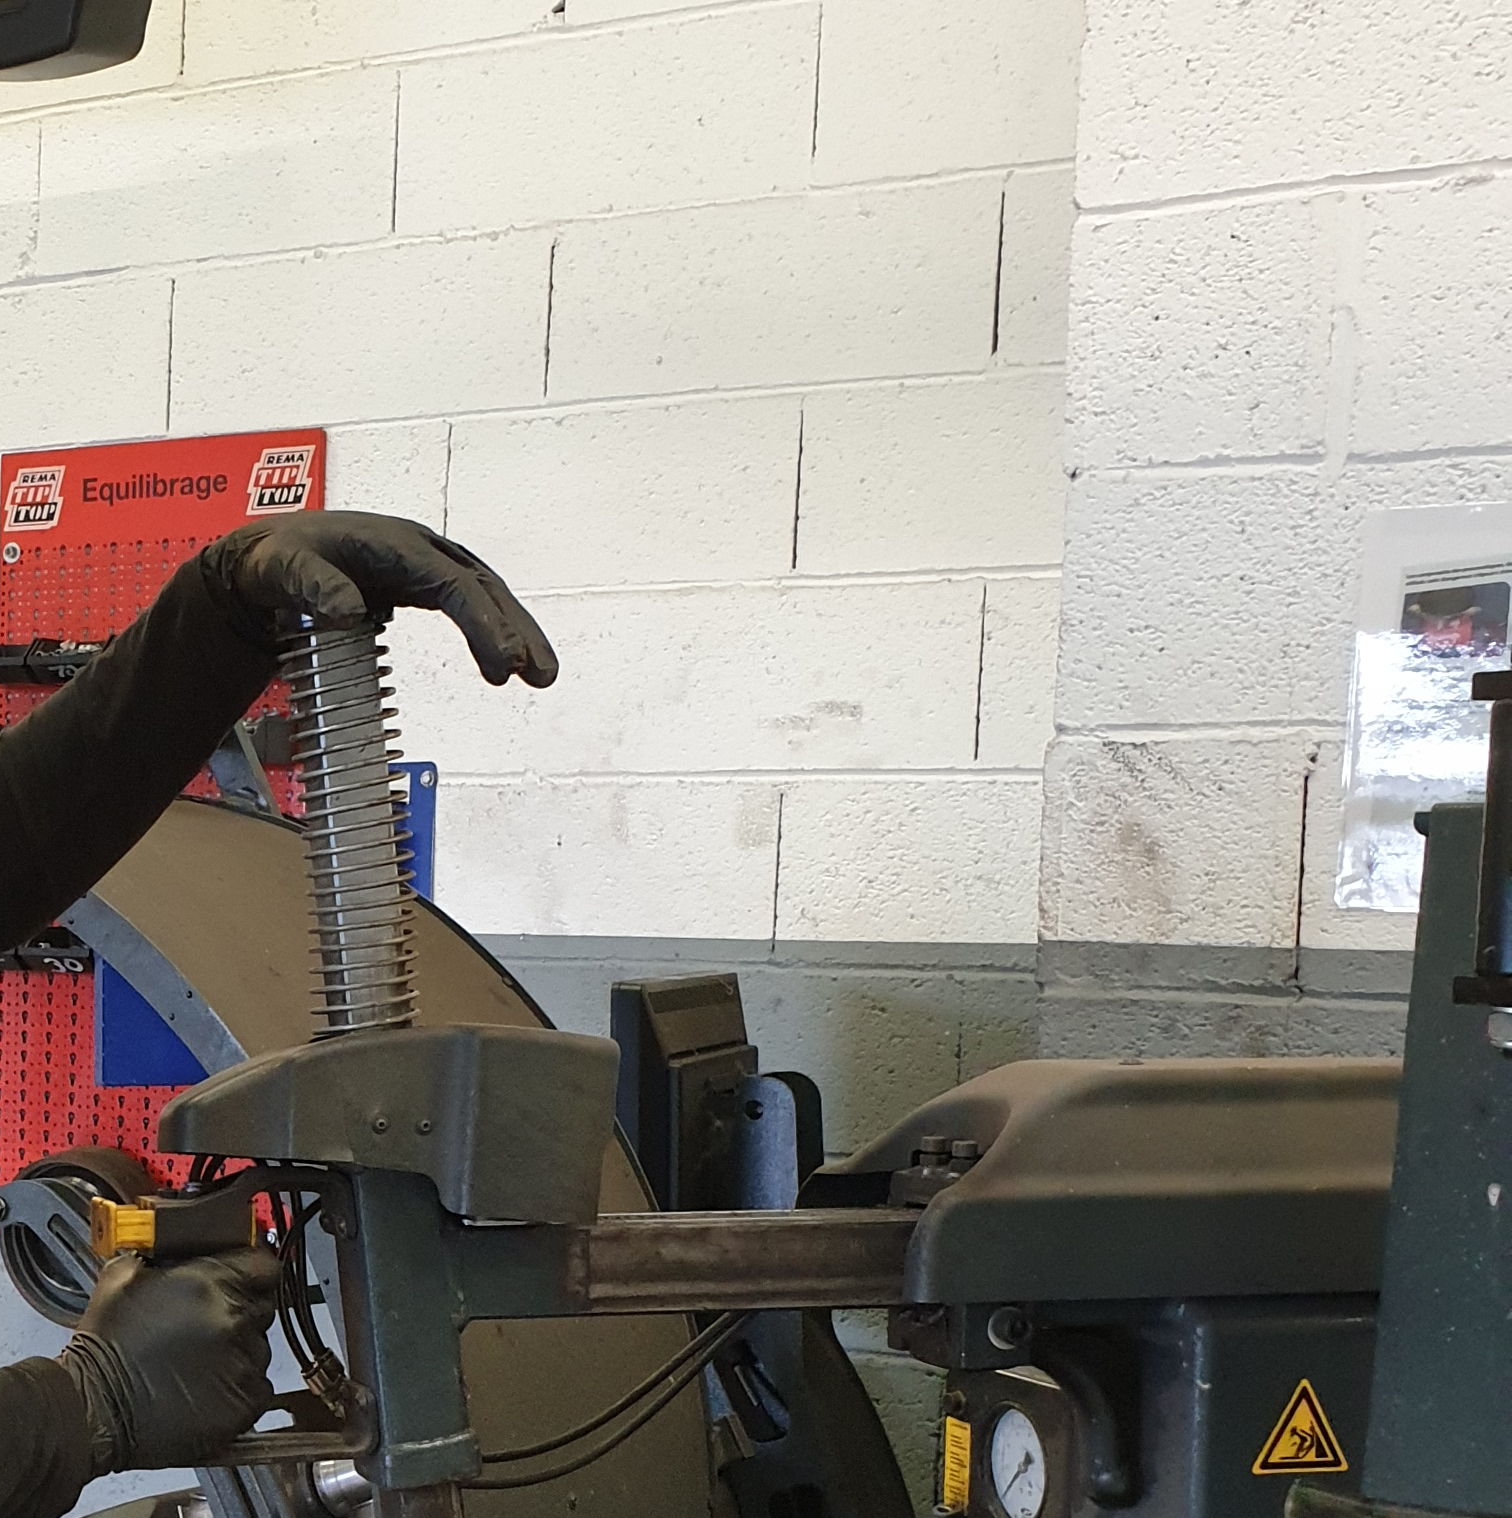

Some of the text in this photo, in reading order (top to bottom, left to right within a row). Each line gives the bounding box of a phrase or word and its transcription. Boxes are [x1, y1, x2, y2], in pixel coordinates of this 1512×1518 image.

[267, 453, 305, 465] REMA
[21, 472, 57, 484] REMA
[257, 467, 299, 486] TIP
[13, 486, 51, 504] TIP
[81, 472, 229, 507] Equilibrage
[260, 486, 304, 505] TOP
[16, 503, 57, 522] TOP
